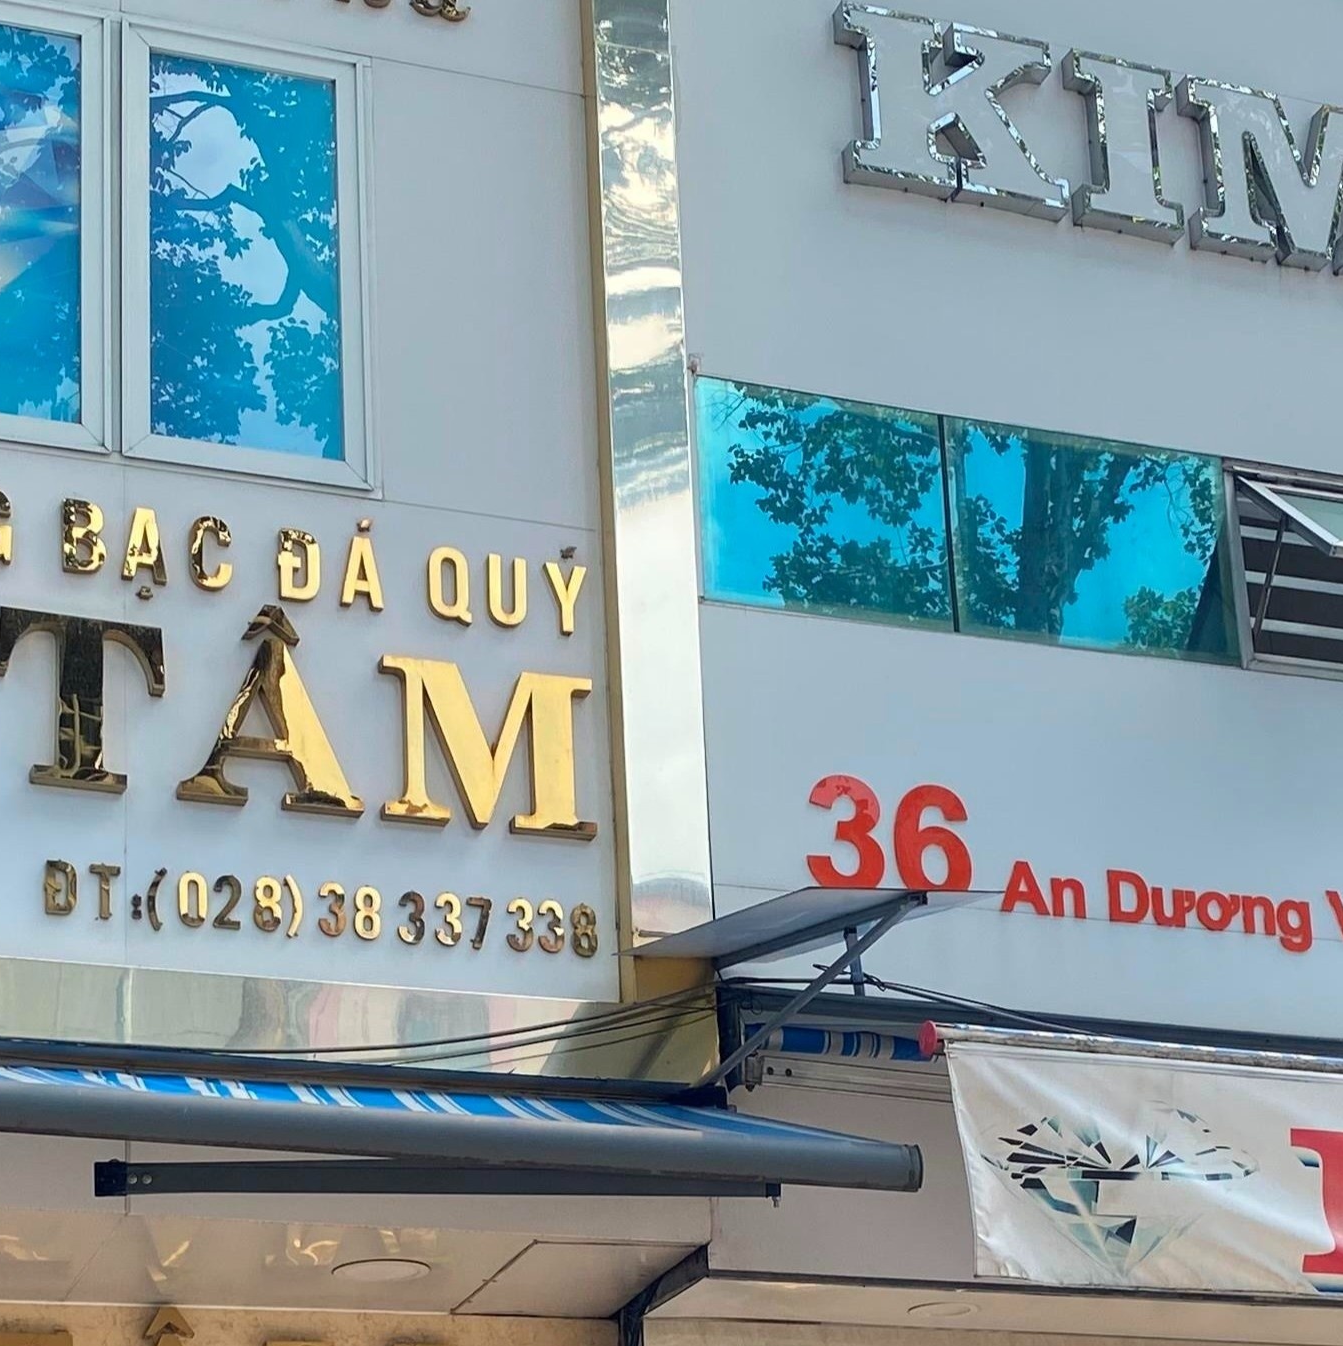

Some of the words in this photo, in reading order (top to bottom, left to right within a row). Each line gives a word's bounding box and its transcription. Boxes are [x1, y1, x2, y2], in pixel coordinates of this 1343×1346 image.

[62, 497, 233, 600] BẠC
[277, 516, 384, 612] ĐÁ
[427, 546, 587, 636] QUÝ
[807, 774, 973, 891] 36
[999, 861, 1087, 920] An
[1106, 869, 1313, 952] Dương
